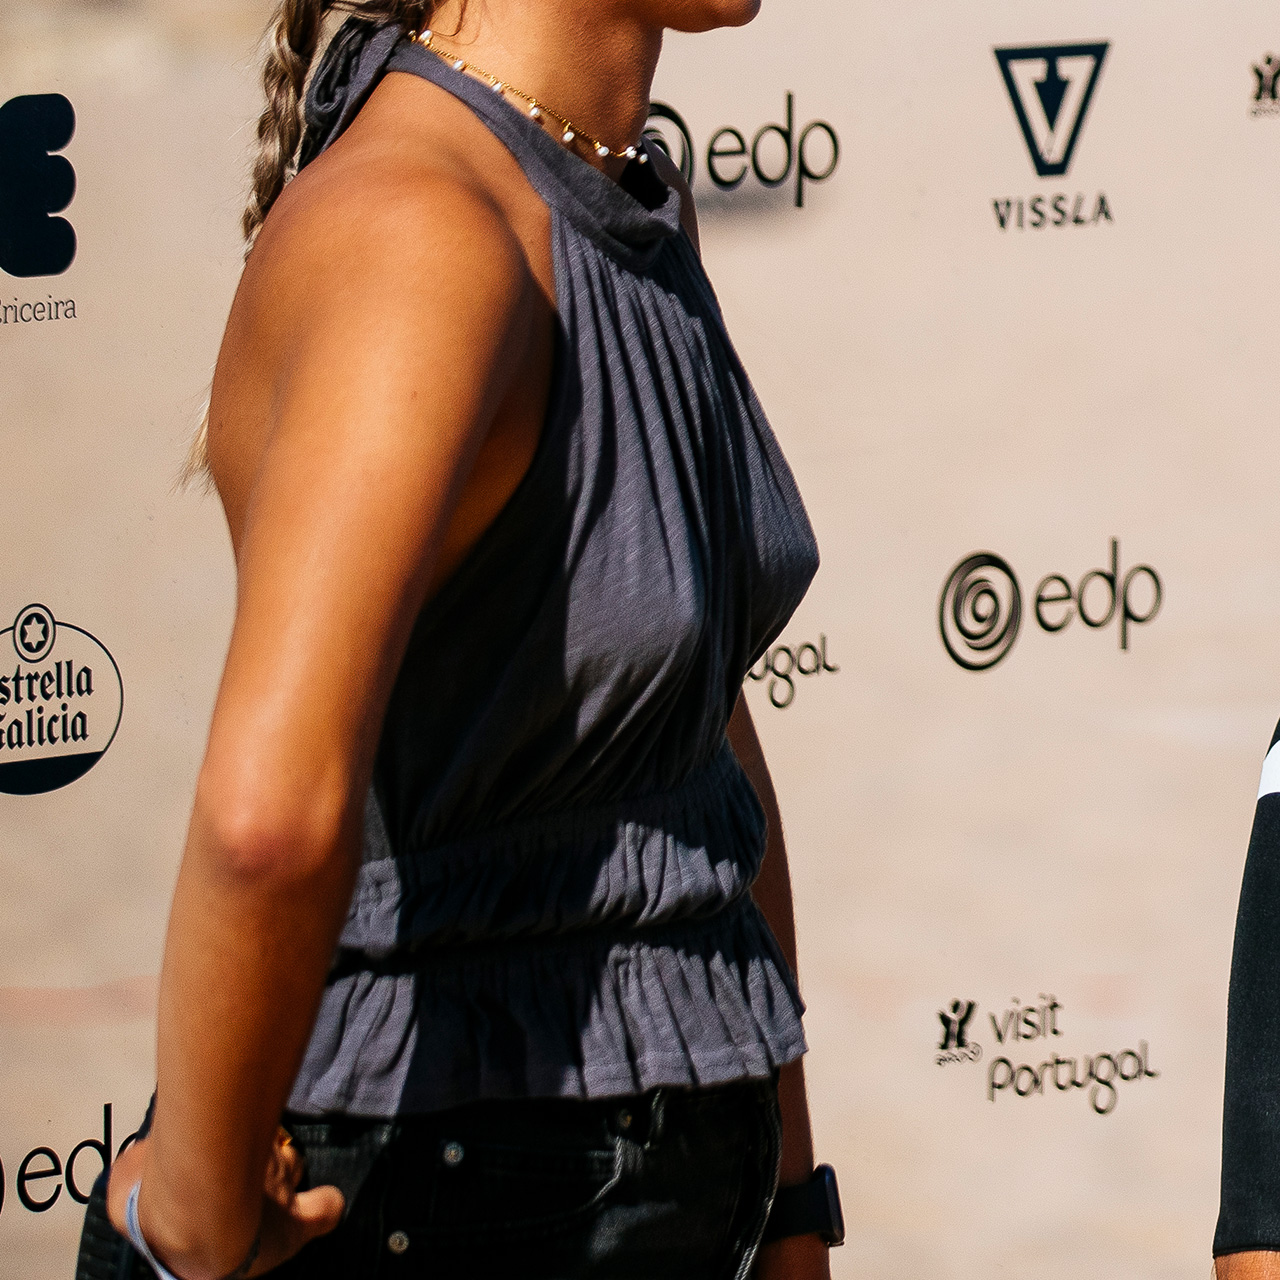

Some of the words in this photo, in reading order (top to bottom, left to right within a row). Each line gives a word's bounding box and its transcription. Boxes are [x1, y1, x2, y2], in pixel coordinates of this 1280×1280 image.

[706, 91, 840, 209] edp
[993, 193, 1115, 231] VISSLA
[0, 294, 77, 324] riceira
[1034, 537, 1164, 651] edp
[989, 993, 1063, 1045] visit
[987, 1041, 1160, 1116] Portugal
[16, 1102, 138, 1213] ed
